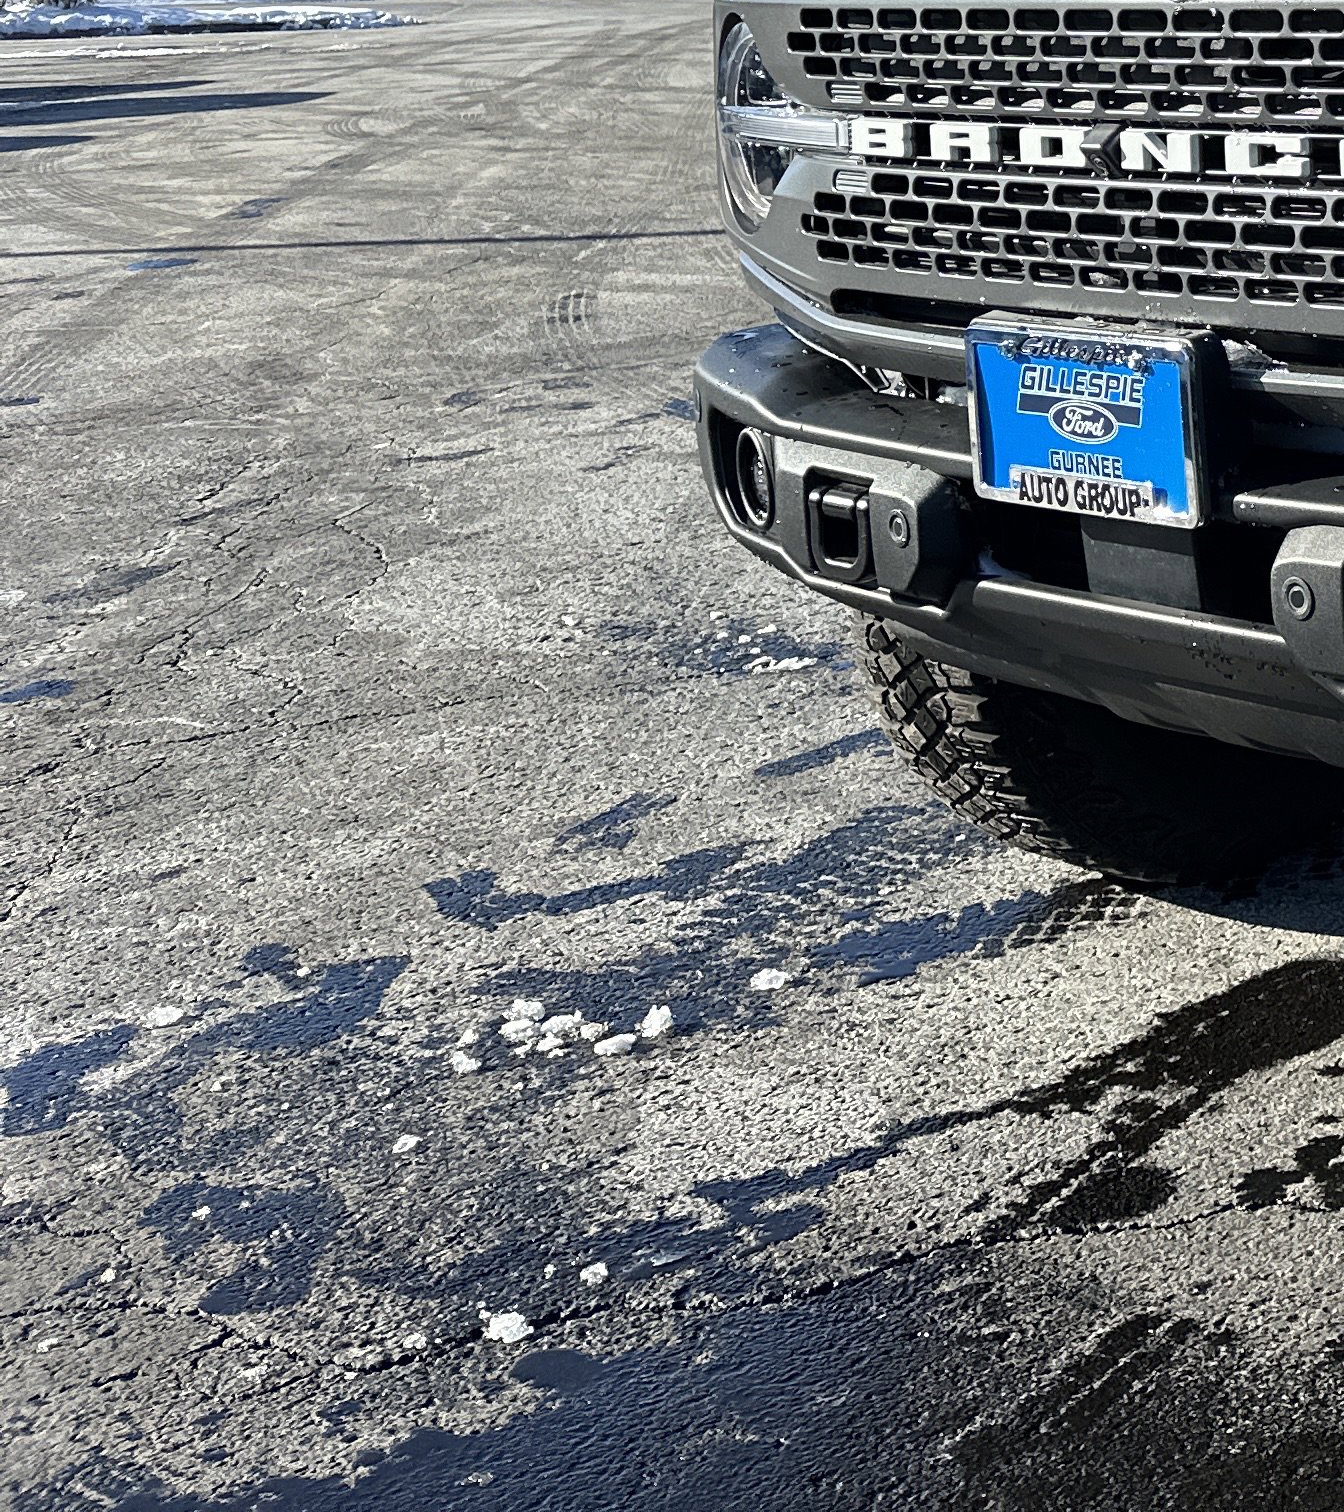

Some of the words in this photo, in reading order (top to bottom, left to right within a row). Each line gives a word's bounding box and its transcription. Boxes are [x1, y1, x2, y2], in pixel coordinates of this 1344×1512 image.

[1019, 364, 1145, 405] GILLESPIE
[1062, 405, 1105, 437] Ford
[1049, 449, 1122, 479] GURNEE
[1019, 472, 1068, 507] AUTO
[1074, 481, 1142, 517] GROUP
